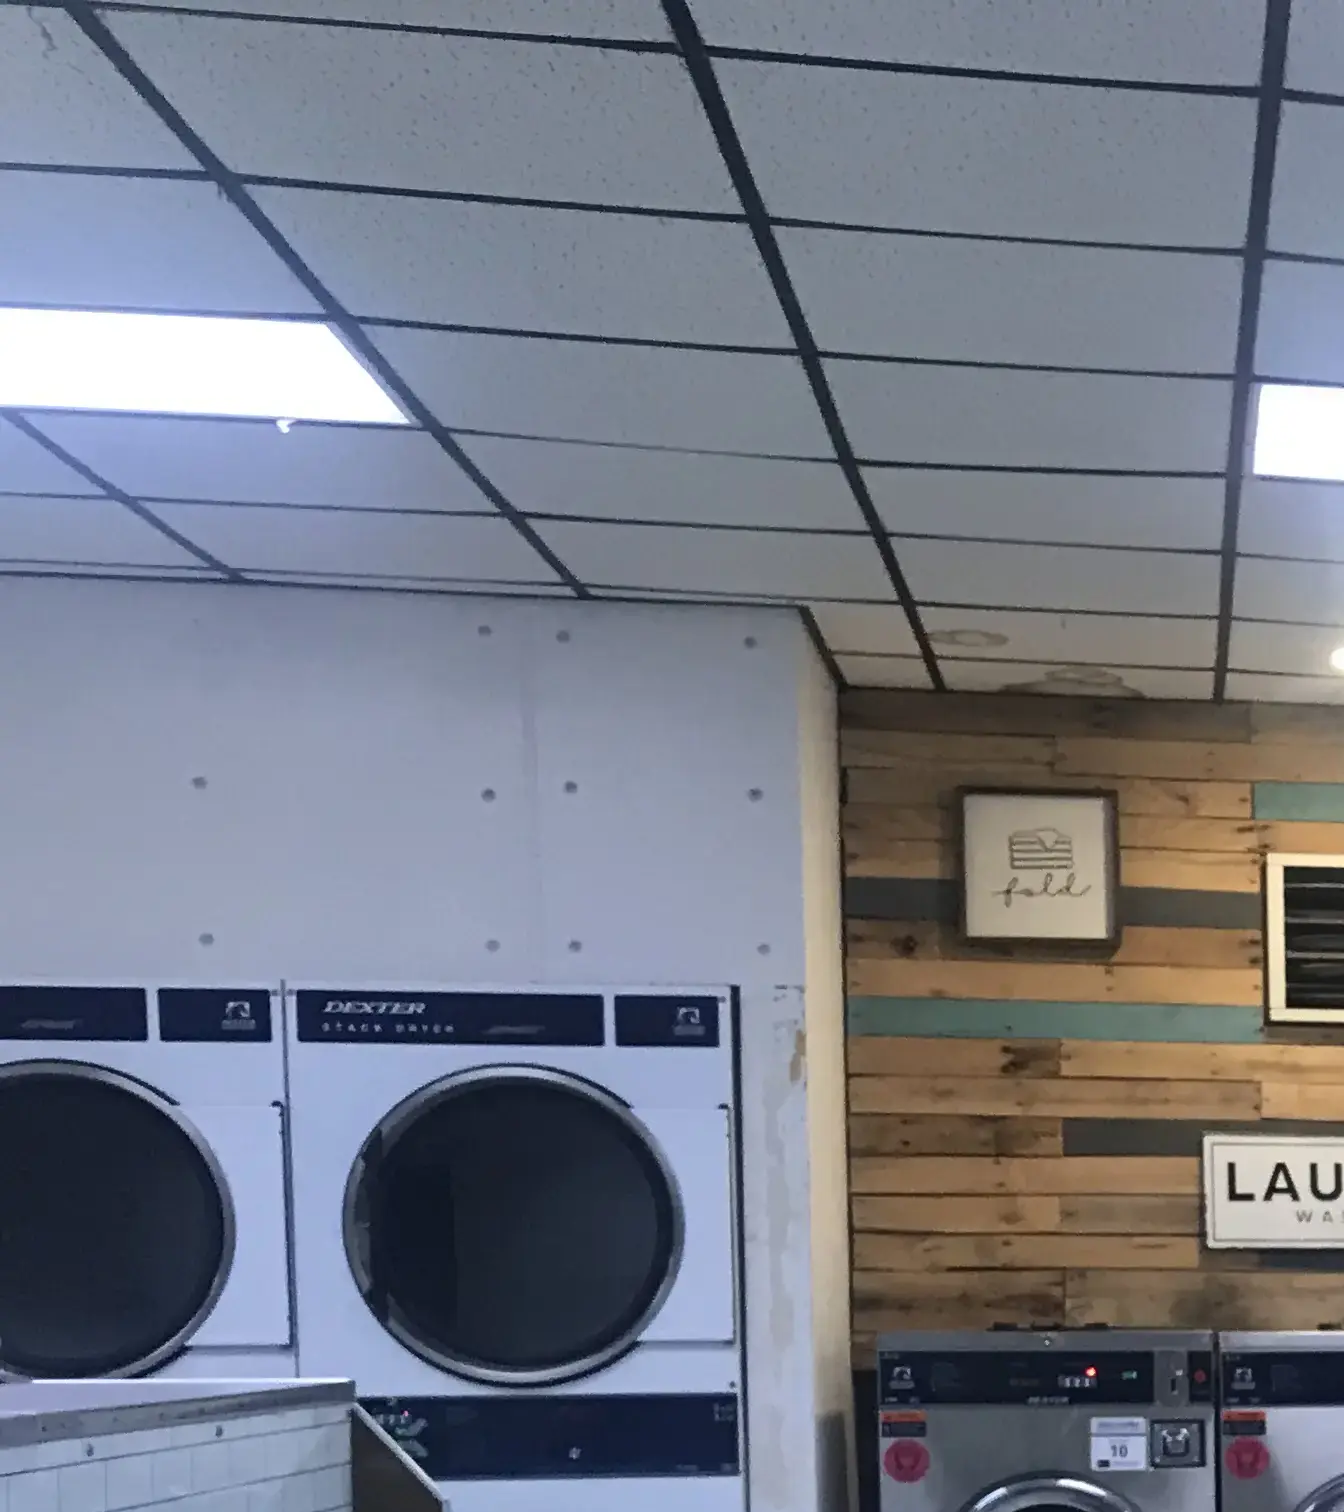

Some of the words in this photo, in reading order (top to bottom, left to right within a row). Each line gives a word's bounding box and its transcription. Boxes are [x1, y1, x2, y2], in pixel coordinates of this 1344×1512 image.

[990, 872, 1092, 908] fold
[322, 1000, 426, 1014] DEXTER
[1110, 1444, 1128, 1458] 10
